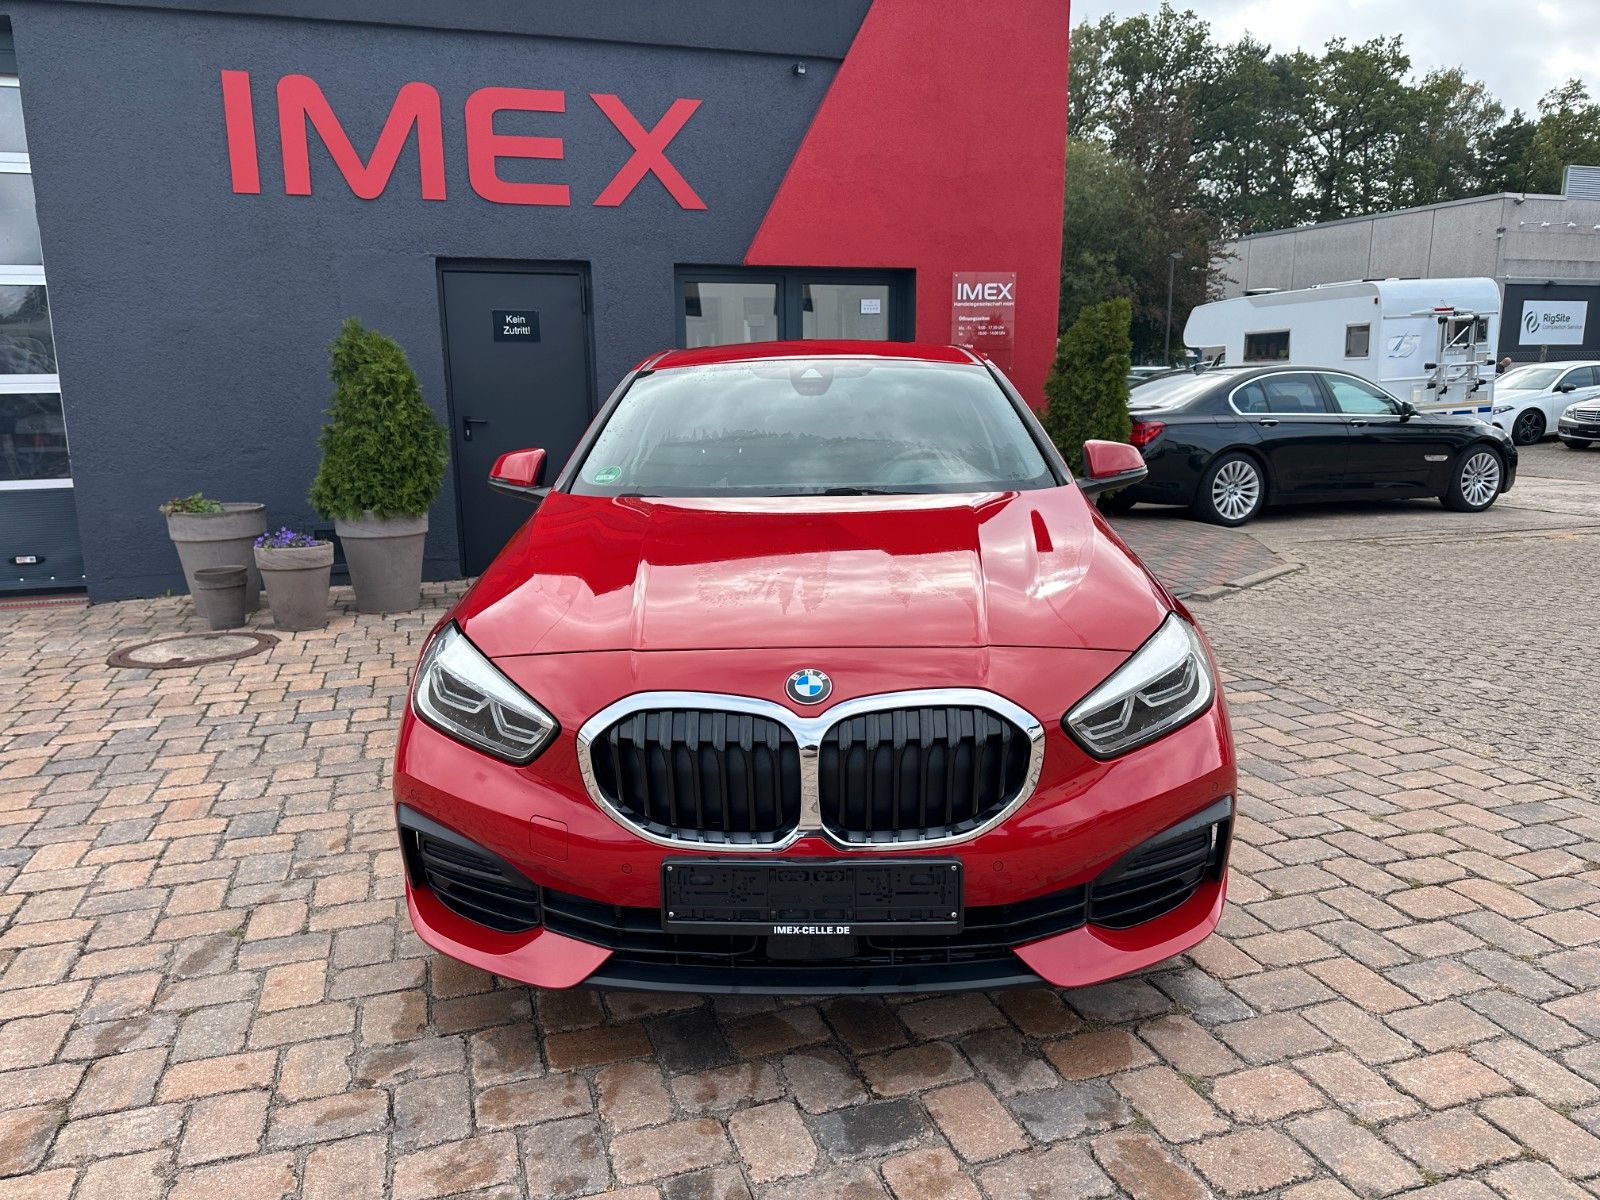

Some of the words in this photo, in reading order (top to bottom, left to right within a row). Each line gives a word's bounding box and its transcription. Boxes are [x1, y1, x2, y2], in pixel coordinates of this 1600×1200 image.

[220, 70, 708, 210] IMEX
[957, 283, 1013, 300] IMEX
[505, 315, 526, 324] Kein
[1543, 313, 1571, 325] RigSite
[503, 326, 531, 335] Zutritt!
[773, 926, 850, 935] IMEX-CELLE.DE
